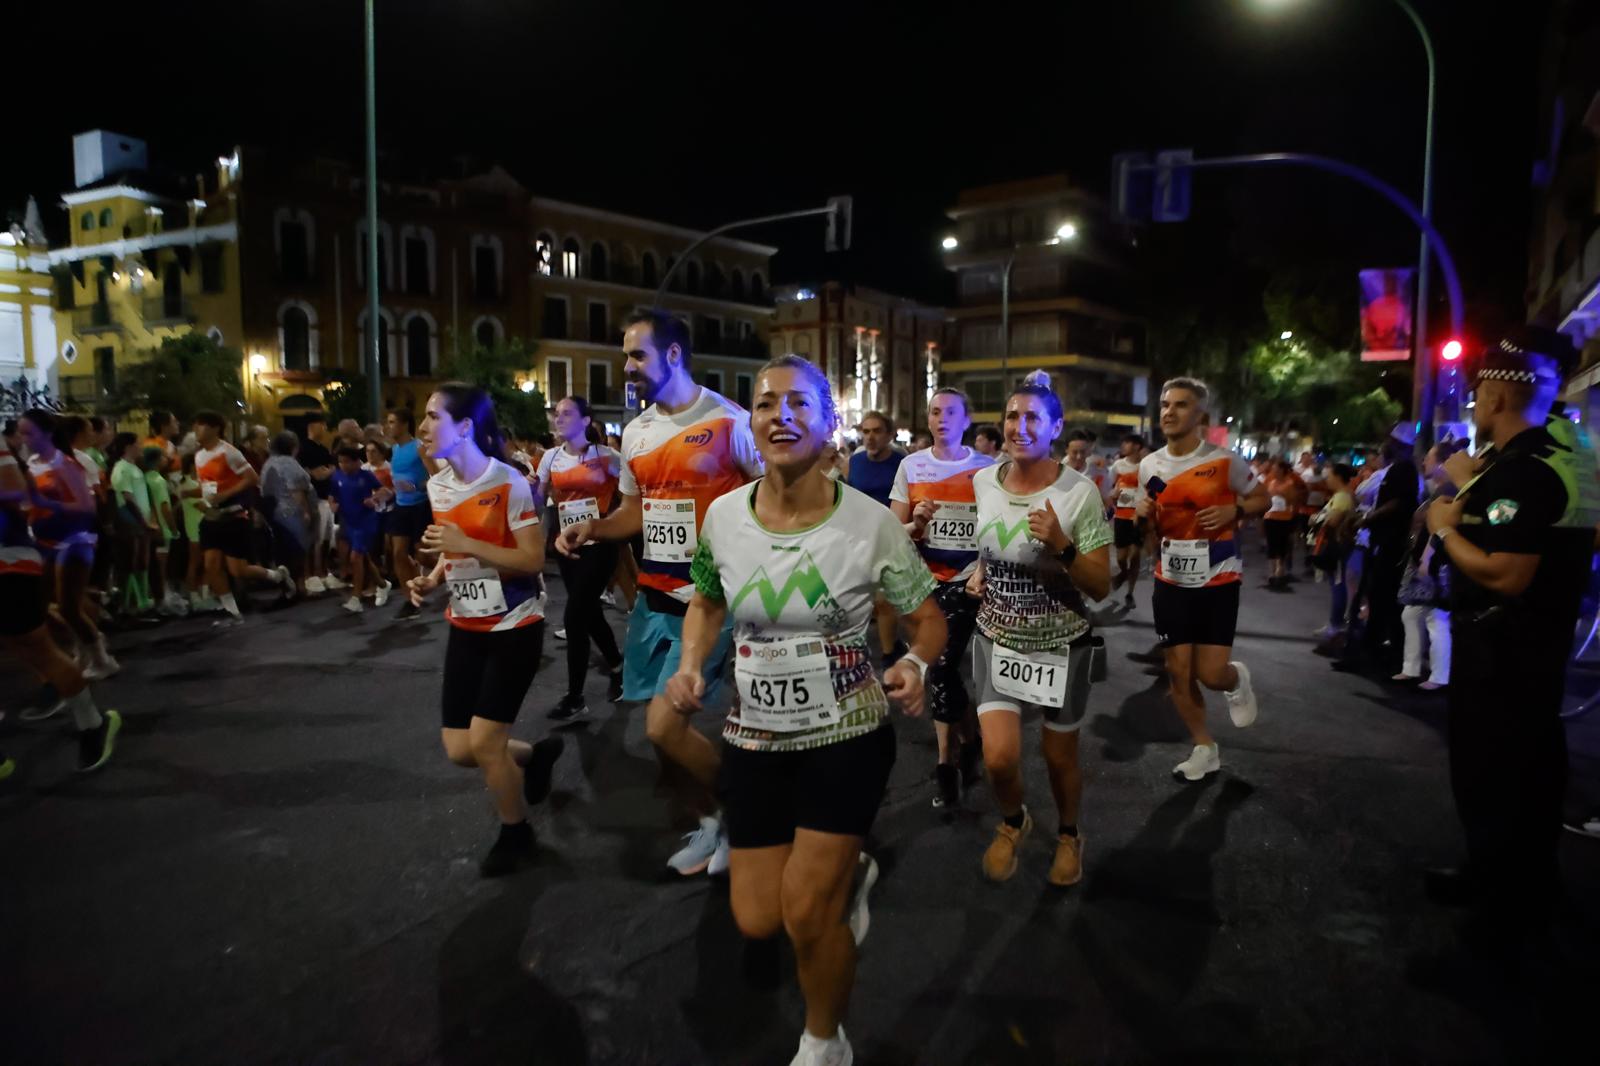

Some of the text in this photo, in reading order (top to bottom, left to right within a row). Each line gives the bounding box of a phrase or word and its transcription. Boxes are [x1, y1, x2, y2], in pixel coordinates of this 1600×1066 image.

[647, 524, 687, 545] 22519
[932, 521, 975, 537] 14230
[1168, 556, 1198, 572] 4377
[453, 581, 488, 601] 3401
[999, 659, 1055, 688] 20011
[750, 677, 810, 708] 4375
